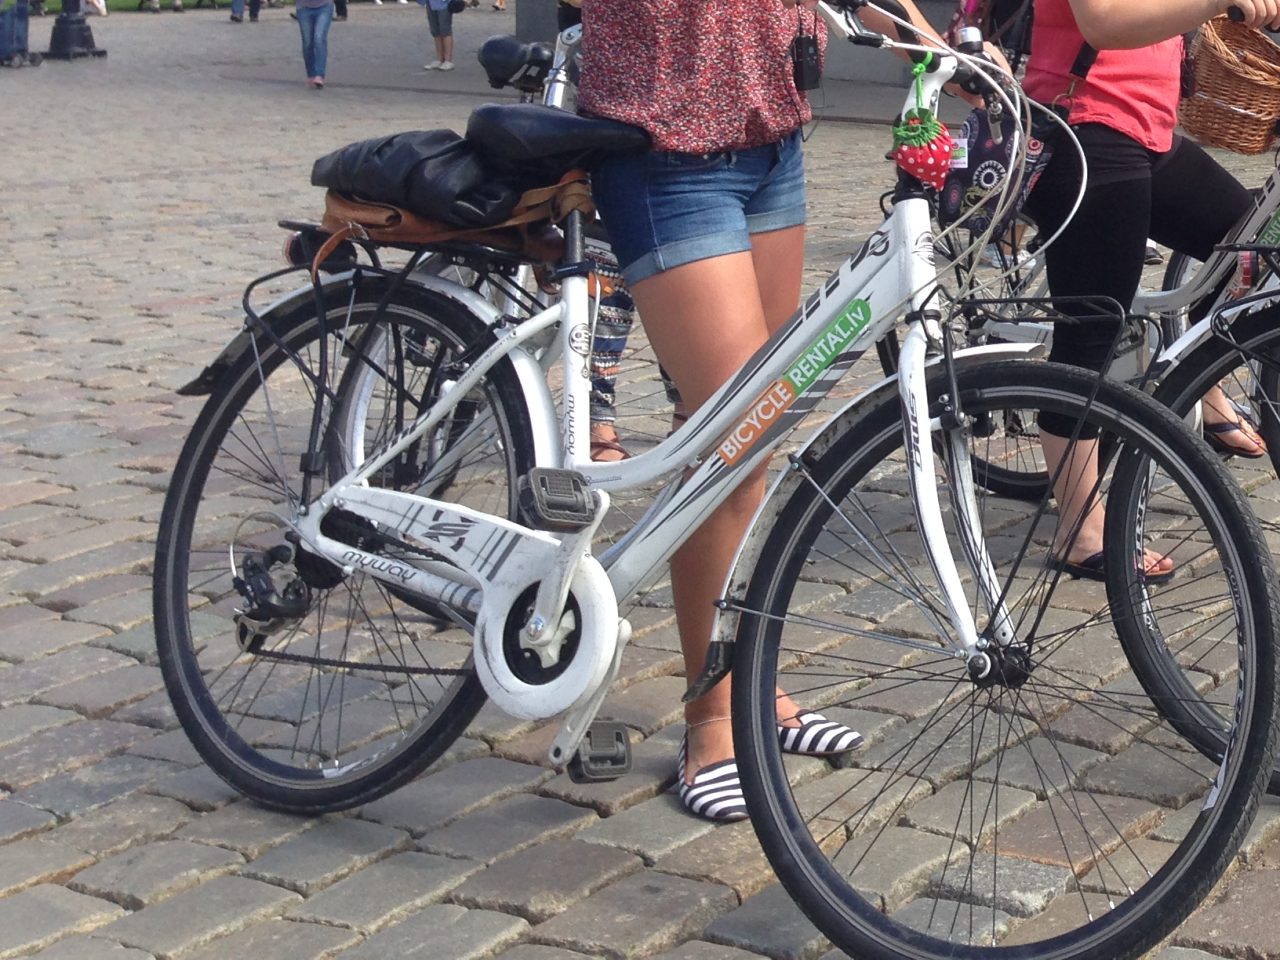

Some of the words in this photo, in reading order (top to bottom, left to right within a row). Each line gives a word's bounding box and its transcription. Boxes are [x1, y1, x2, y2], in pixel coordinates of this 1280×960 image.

[720, 382, 792, 460] BICYCLE
[788, 305, 865, 388] RENTAL.lv
[565, 393, 576, 456] myway
[342, 549, 417, 580] myway
